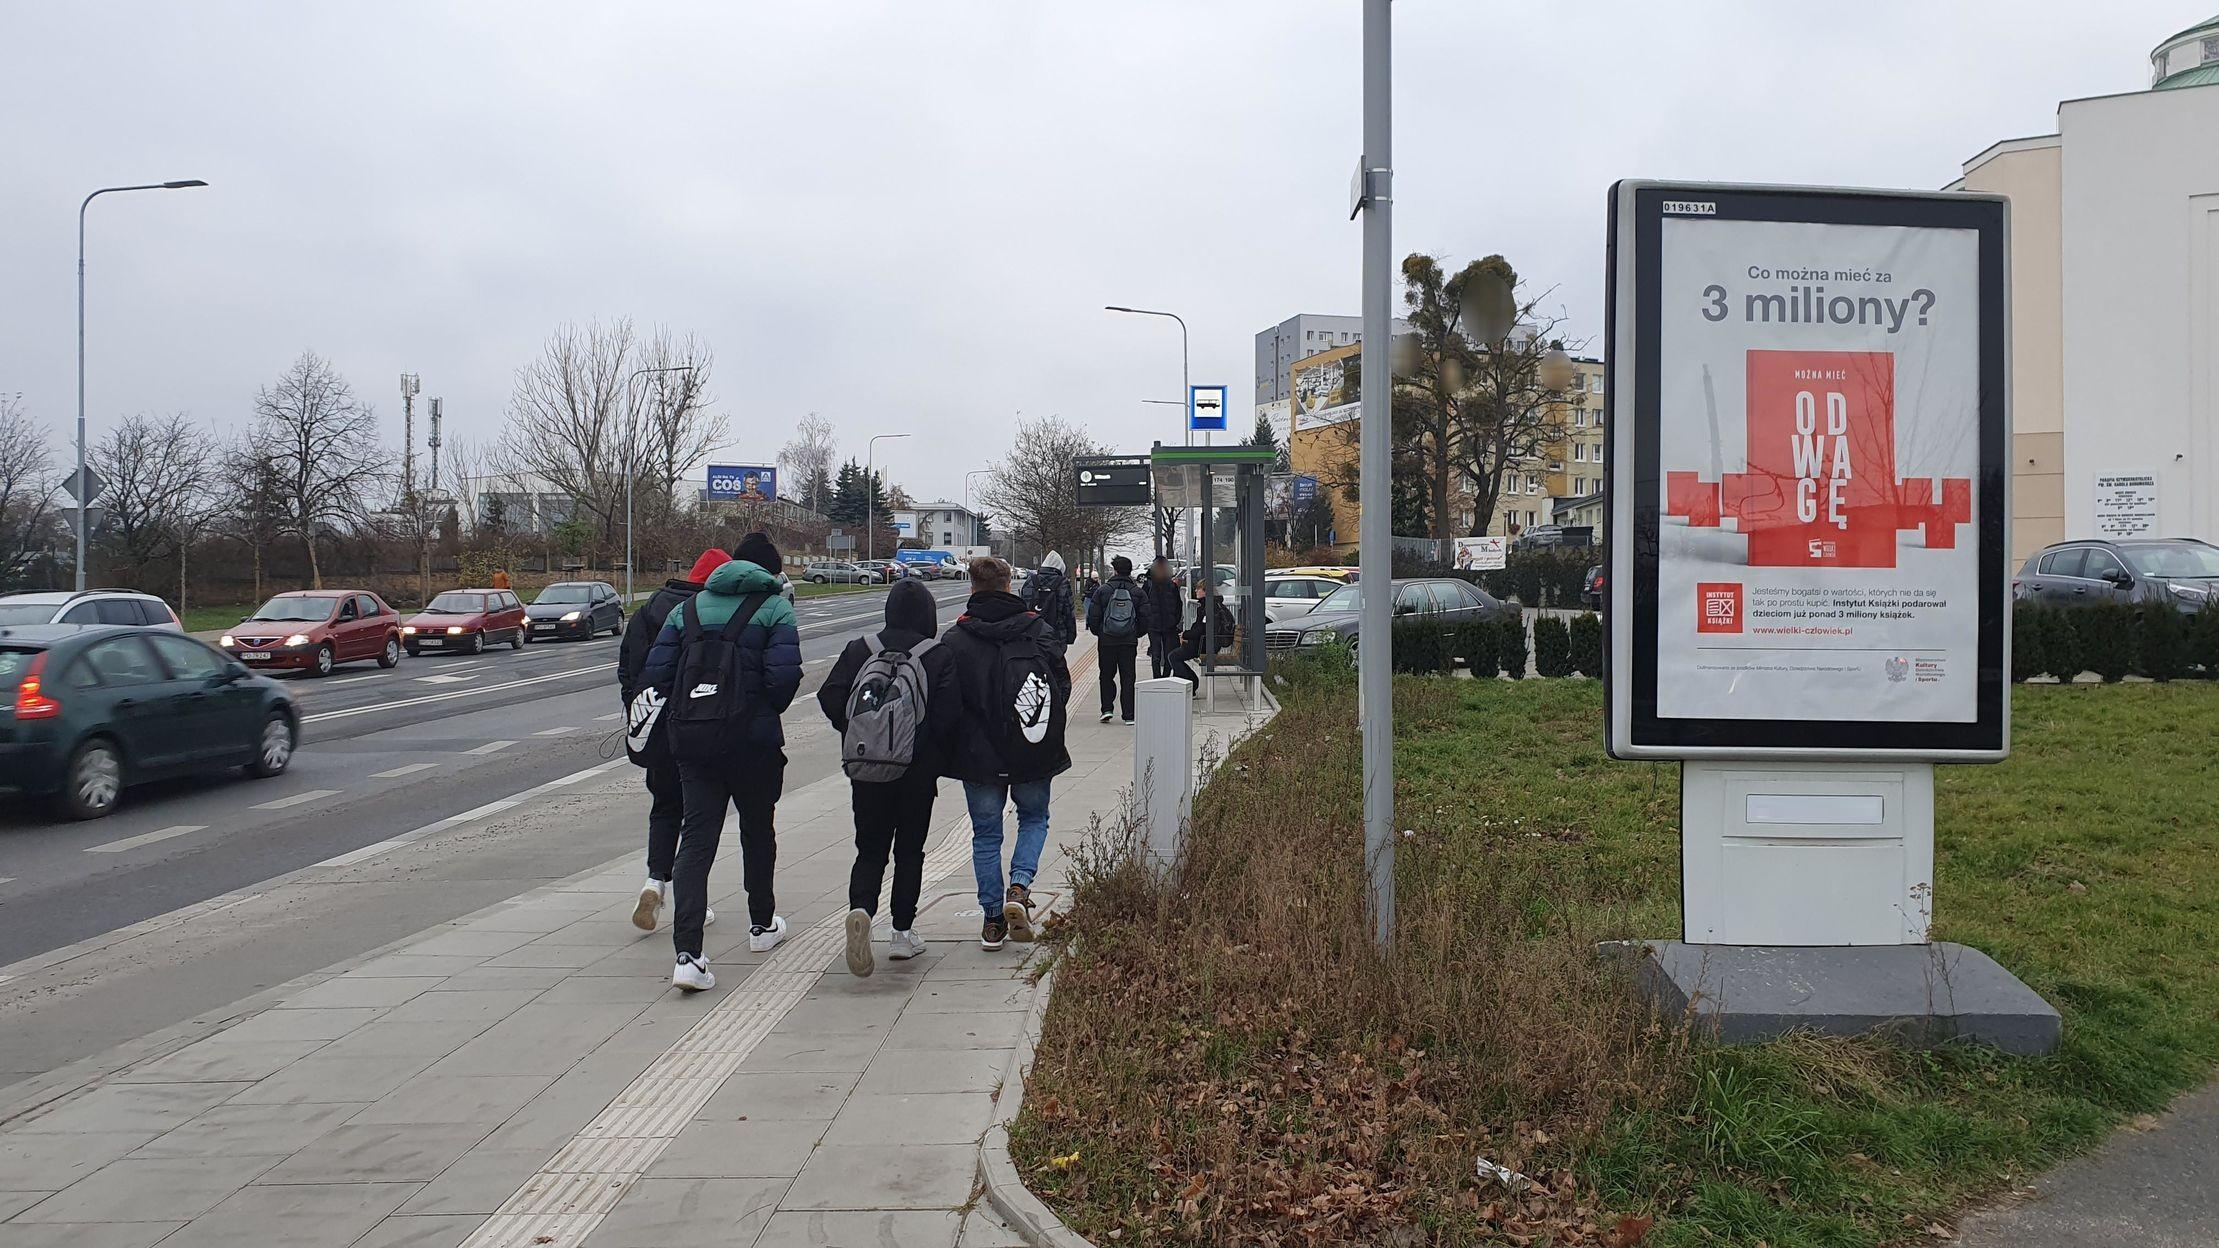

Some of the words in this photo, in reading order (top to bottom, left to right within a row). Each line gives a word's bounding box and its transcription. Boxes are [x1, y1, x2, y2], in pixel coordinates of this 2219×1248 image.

[1663, 203, 1716, 213] 019631A
[1748, 265, 1771, 279] Co
[1776, 267, 1830, 281] można
[1834, 268, 1872, 283] mieć
[1875, 272, 1892, 283] za
[1701, 284, 1729, 322] 3
[1745, 285, 1936, 334] miliony?
[1795, 369, 1822, 380] MOŻNA
[1826, 368, 1847, 380] MIEĆ
[1706, 591, 1735, 599] INSTYTUT
[1752, 586, 1790, 597] Jesteśmy
[1791, 587, 1821, 597] bogatsi
[1823, 588, 1829, 596] o
[1830, 587, 1867, 598] wartości,
[1868, 588, 1898, 598] których
[1900, 588, 1912, 597] nie
[1913, 588, 1924, 597] da
[1925, 589, 1937, 599] się
[1752, 599, 1764, 607] tak
[1767, 600, 1778, 608] po
[1780, 599, 1805, 608] prostu
[1833, 599, 1867, 609] Instytut
[1868, 599, 1900, 609] Książki
[1901, 600, 1947, 609] podarował
[1752, 609, 1792, 618] dzieciom
[1793, 609, 1807, 619] już
[1808, 610, 1837, 619] ponad
[1838, 610, 1845, 618] 3
[1846, 610, 1878, 620] miliony
[1879, 610, 1916, 620] książek.
[695, 683, 719, 692] NIKE
